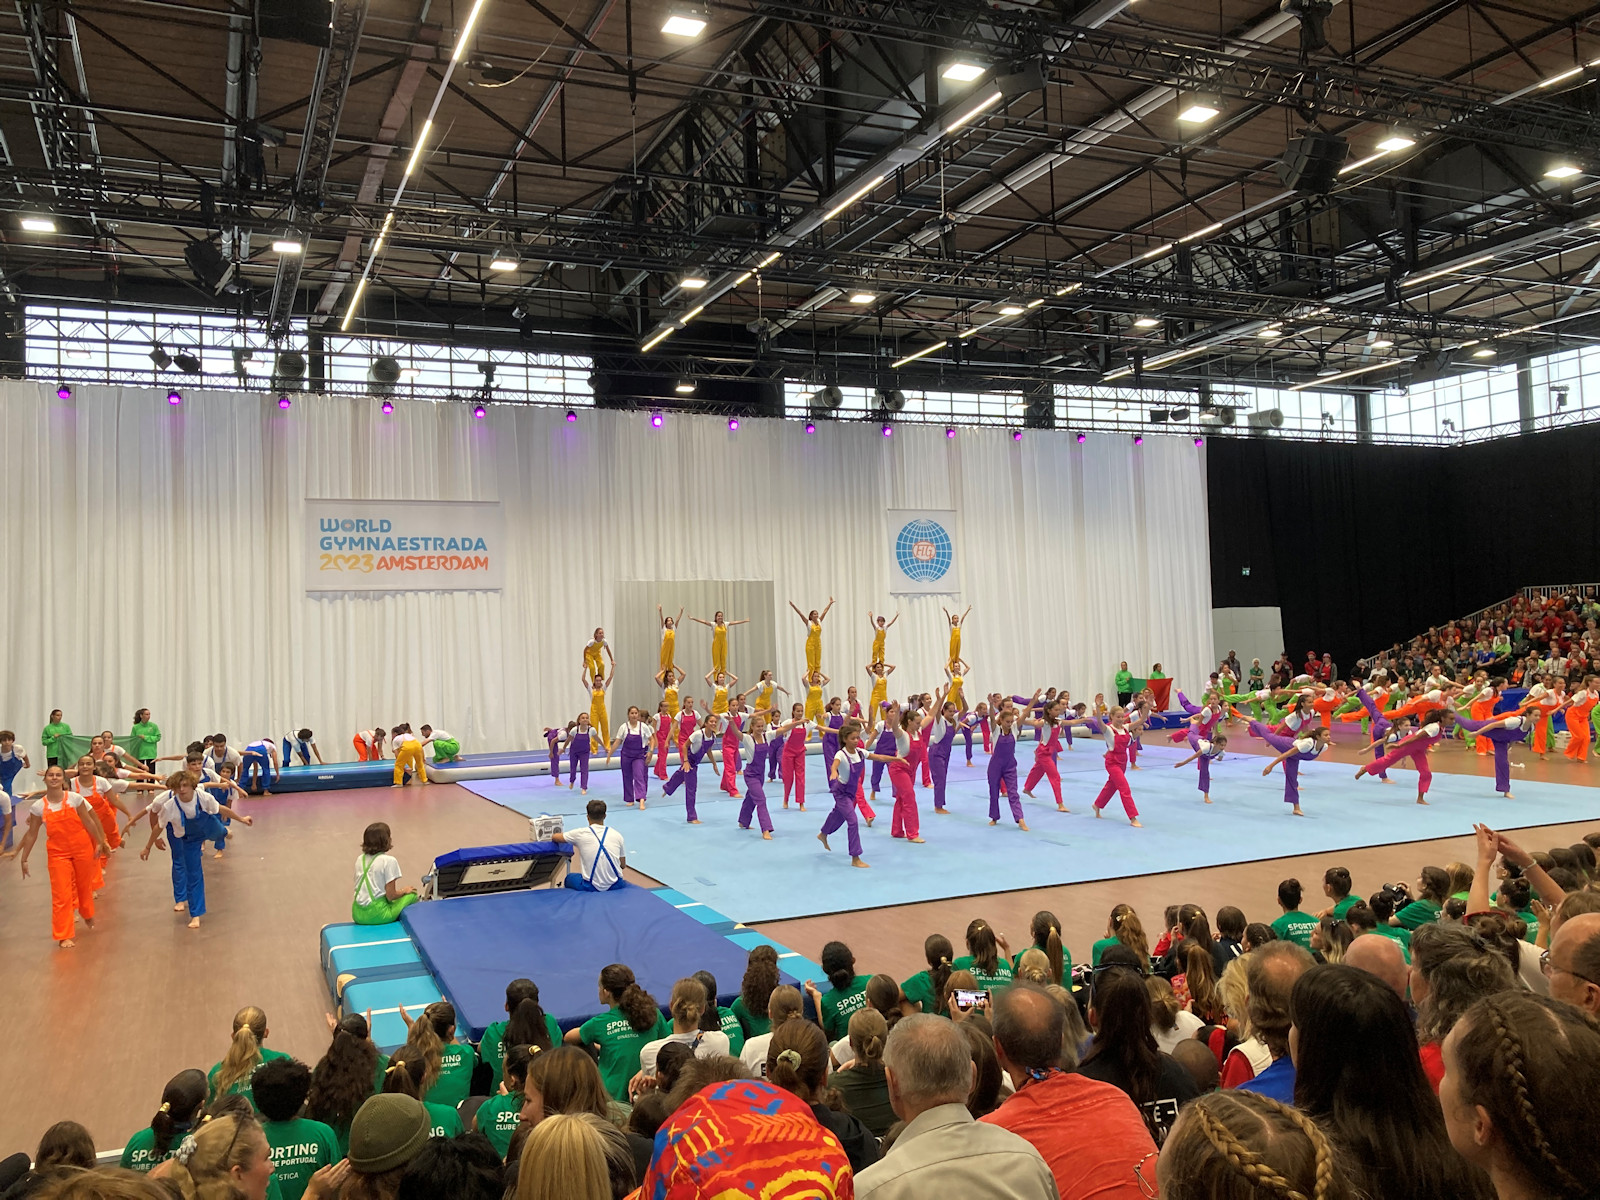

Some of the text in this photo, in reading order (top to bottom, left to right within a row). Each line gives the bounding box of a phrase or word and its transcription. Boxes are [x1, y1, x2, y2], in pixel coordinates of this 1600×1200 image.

[319, 518, 392, 533] WORLD
[319, 536, 488, 551] GYMNAESTRADA
[319, 553, 489, 573] 2023 AMSTERDAM
[836, 990, 867, 1011] SPORT
[606, 1020, 629, 1031] SPOR
[441, 1054, 462, 1064] TING
[268, 1143, 319, 1159] ORTING
[281, 1157, 318, 1167] PORTUGAL
[278, 1172, 299, 1181] STICA
